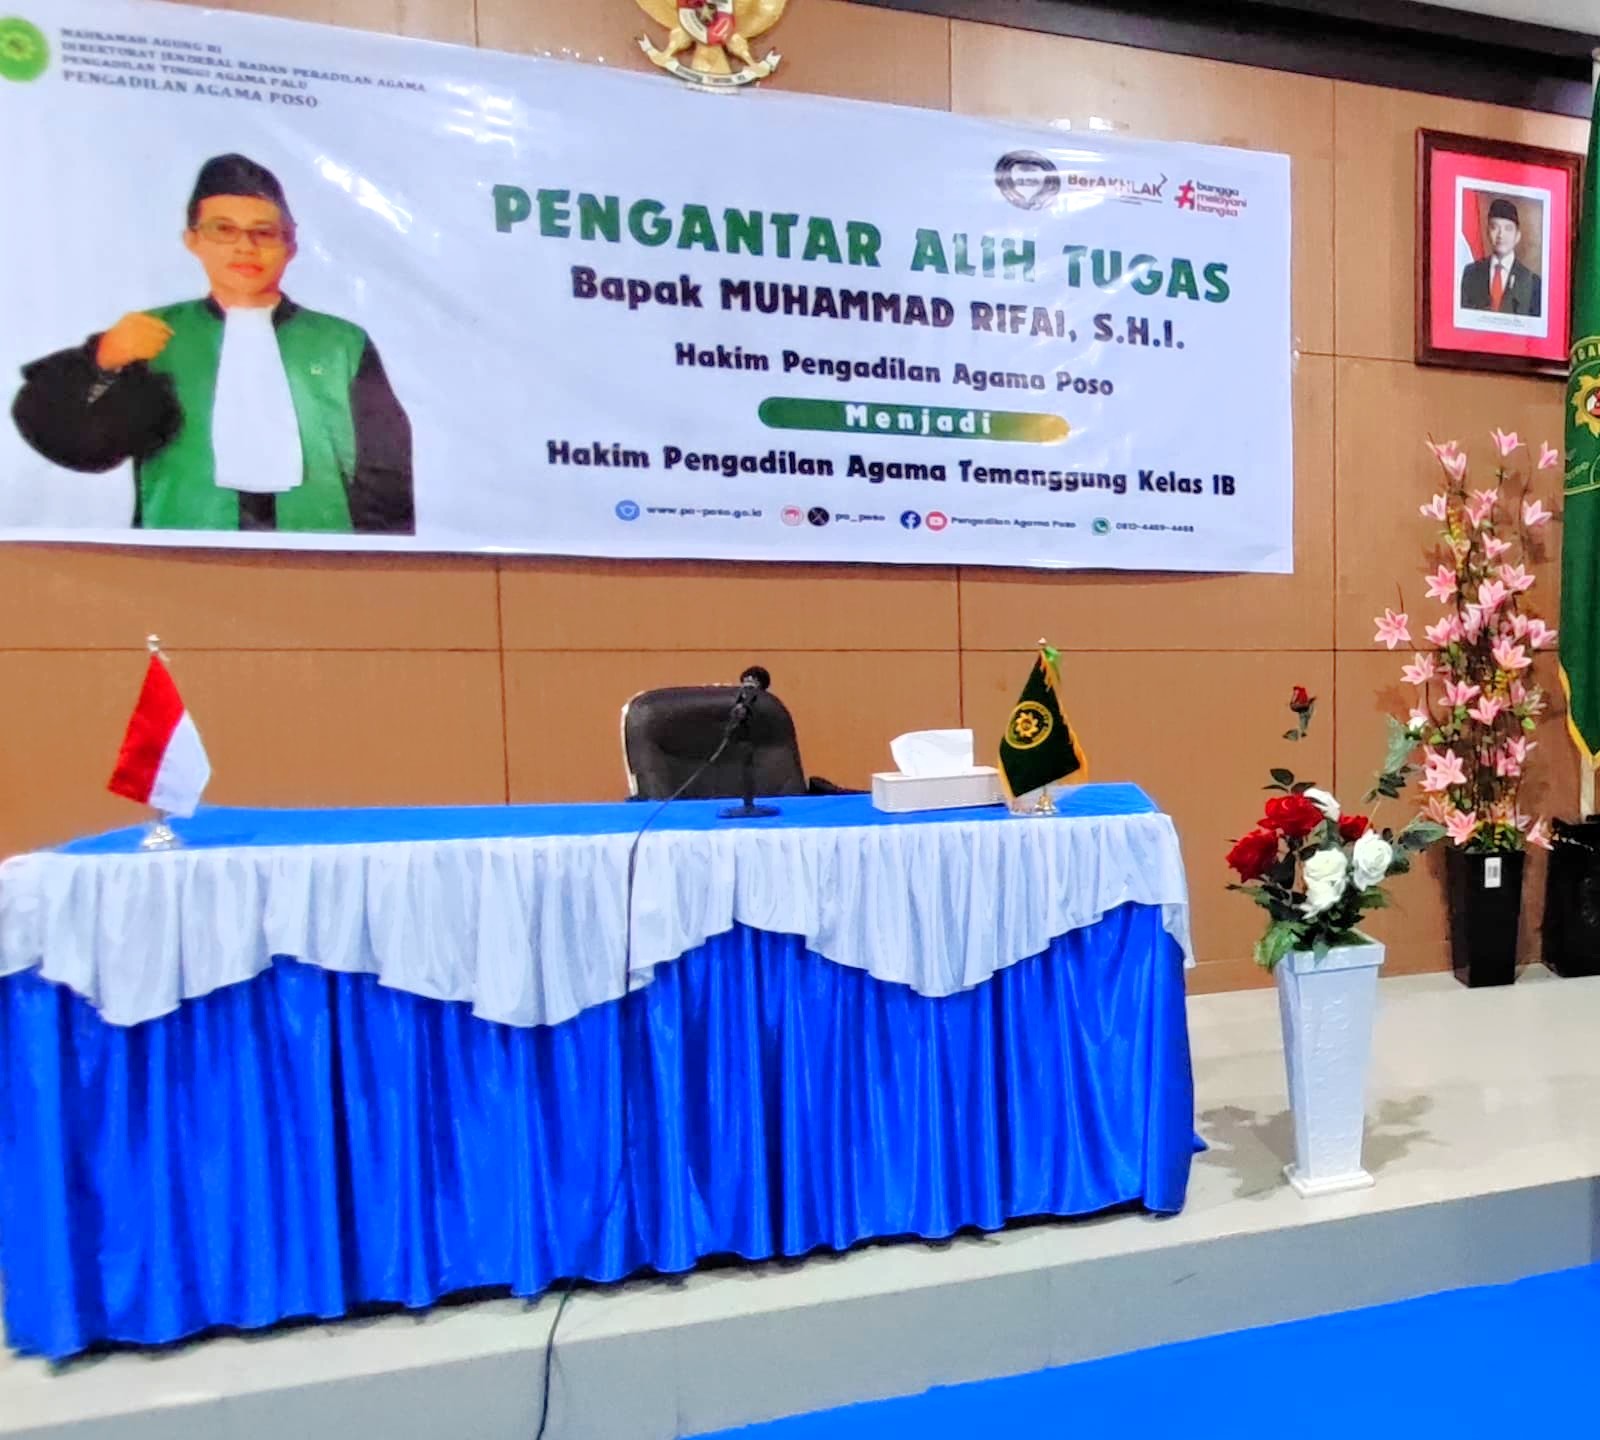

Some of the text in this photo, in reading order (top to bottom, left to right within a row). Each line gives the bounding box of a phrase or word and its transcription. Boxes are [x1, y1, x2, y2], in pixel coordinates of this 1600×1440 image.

[153, 37, 202, 51] AGUNG
[62, 54, 155, 74] PENGADILAN
[215, 70, 267, 85] AGAMA
[270, 78, 309, 90] PALU
[63, 69, 319, 109] PENGADILAN AGAMA POSO
[238, 60, 288, 76] BADAN
[293, 65, 372, 85] PERADILAN
[377, 78, 427, 93] AGAMA
[492, 183, 1231, 303] PENGANTAR ALIH TUGAS
[570, 265, 1186, 350] Bapak MUHAMMAD RIFAI, S.H.I.
[675, 342, 1115, 397] Hakim Pengadilan Agama Poso
[845, 404, 994, 436] Menjadi
[547, 440, 1237, 497] Hakim Pengadilan Agama Temanggung Kelas IB
